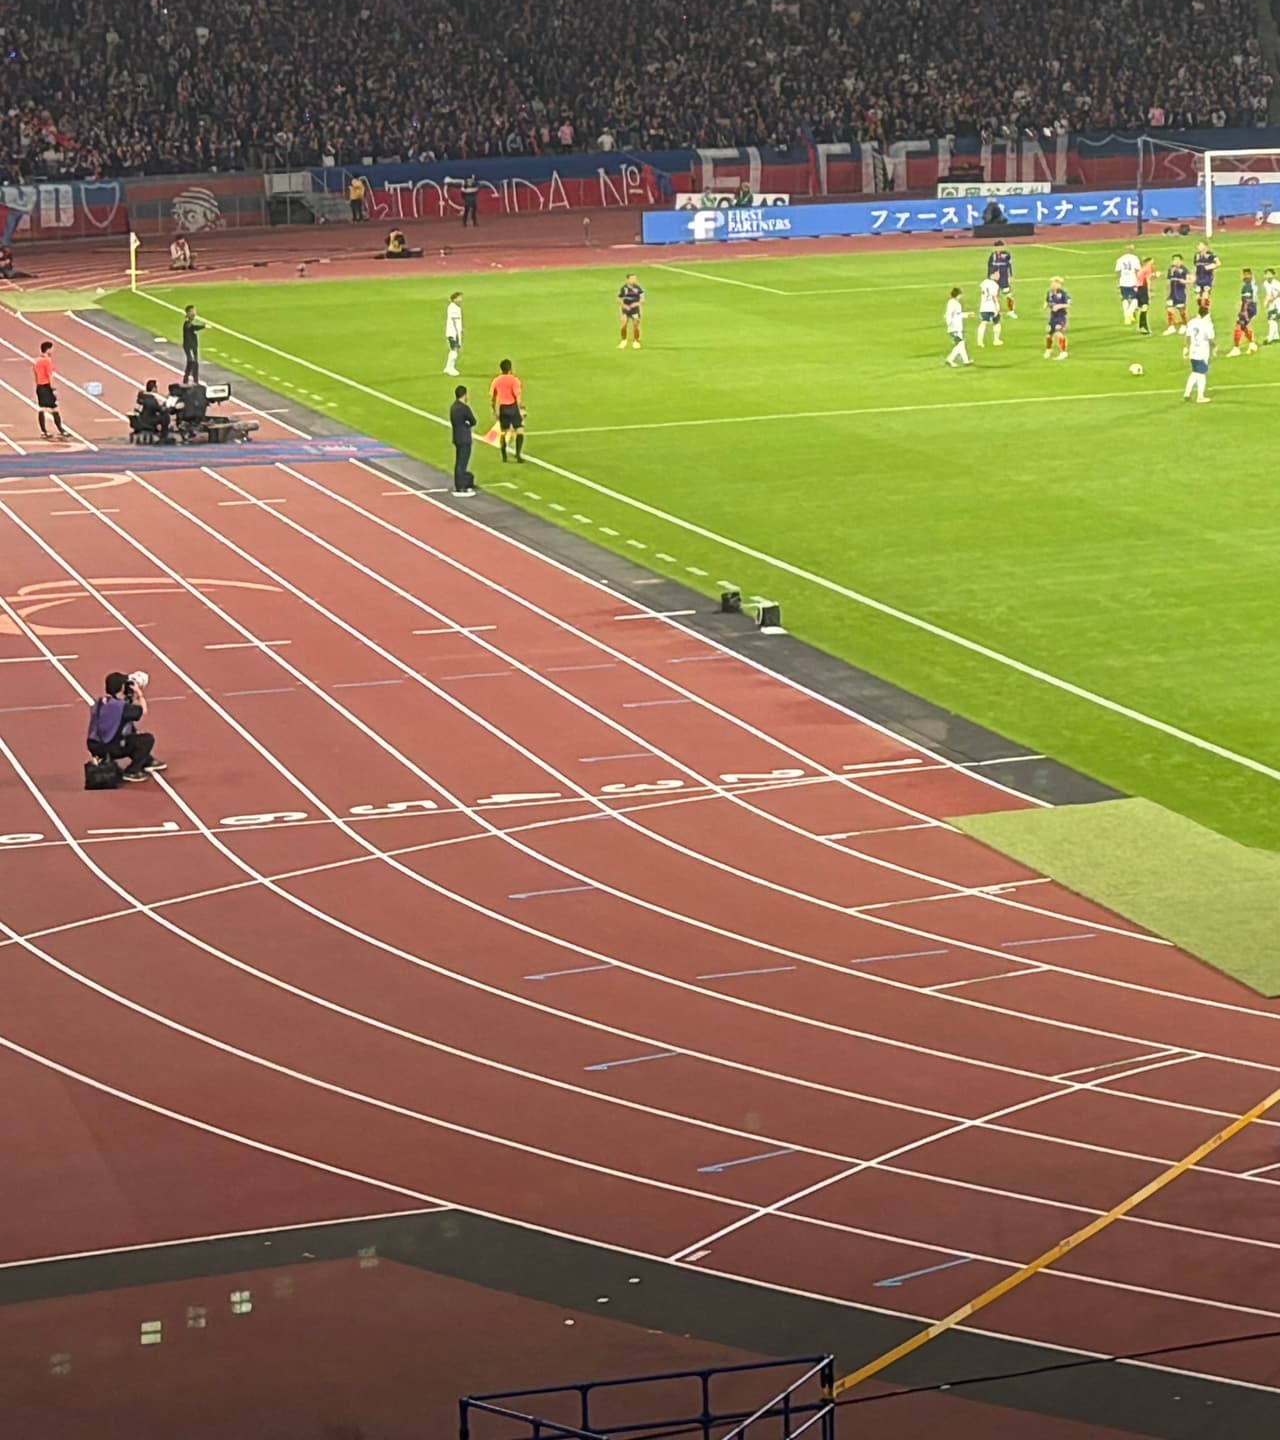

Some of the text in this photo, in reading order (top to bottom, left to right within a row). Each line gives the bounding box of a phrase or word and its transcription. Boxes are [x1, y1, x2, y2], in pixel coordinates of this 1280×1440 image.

[600, 779, 685, 793] 3
[349, 799, 438, 815] 5
[219, 811, 308, 826] 6
